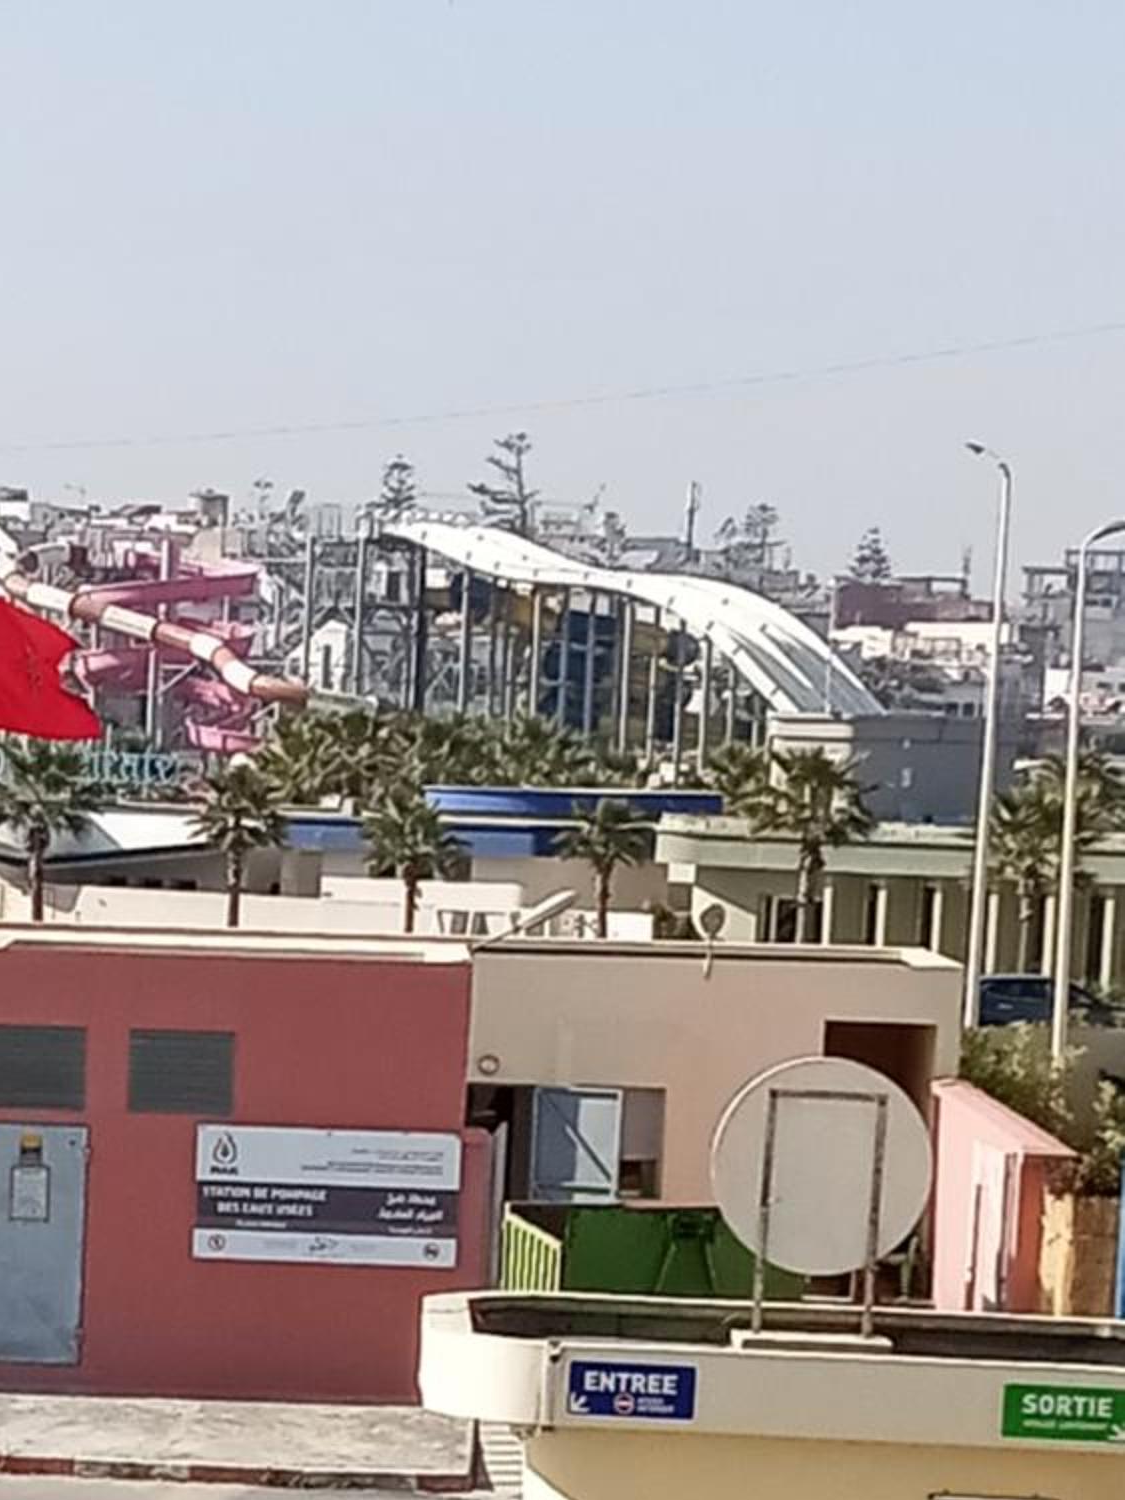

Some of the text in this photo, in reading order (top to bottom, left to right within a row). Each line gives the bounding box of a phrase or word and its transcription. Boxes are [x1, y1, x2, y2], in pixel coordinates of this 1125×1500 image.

[203, 1185, 327, 1202] STATION DE POMPAGE
[217, 1201, 240, 1214] DES
[584, 1370, 679, 1396] ENTREE
[1021, 1393, 1114, 1418] SORTIE
